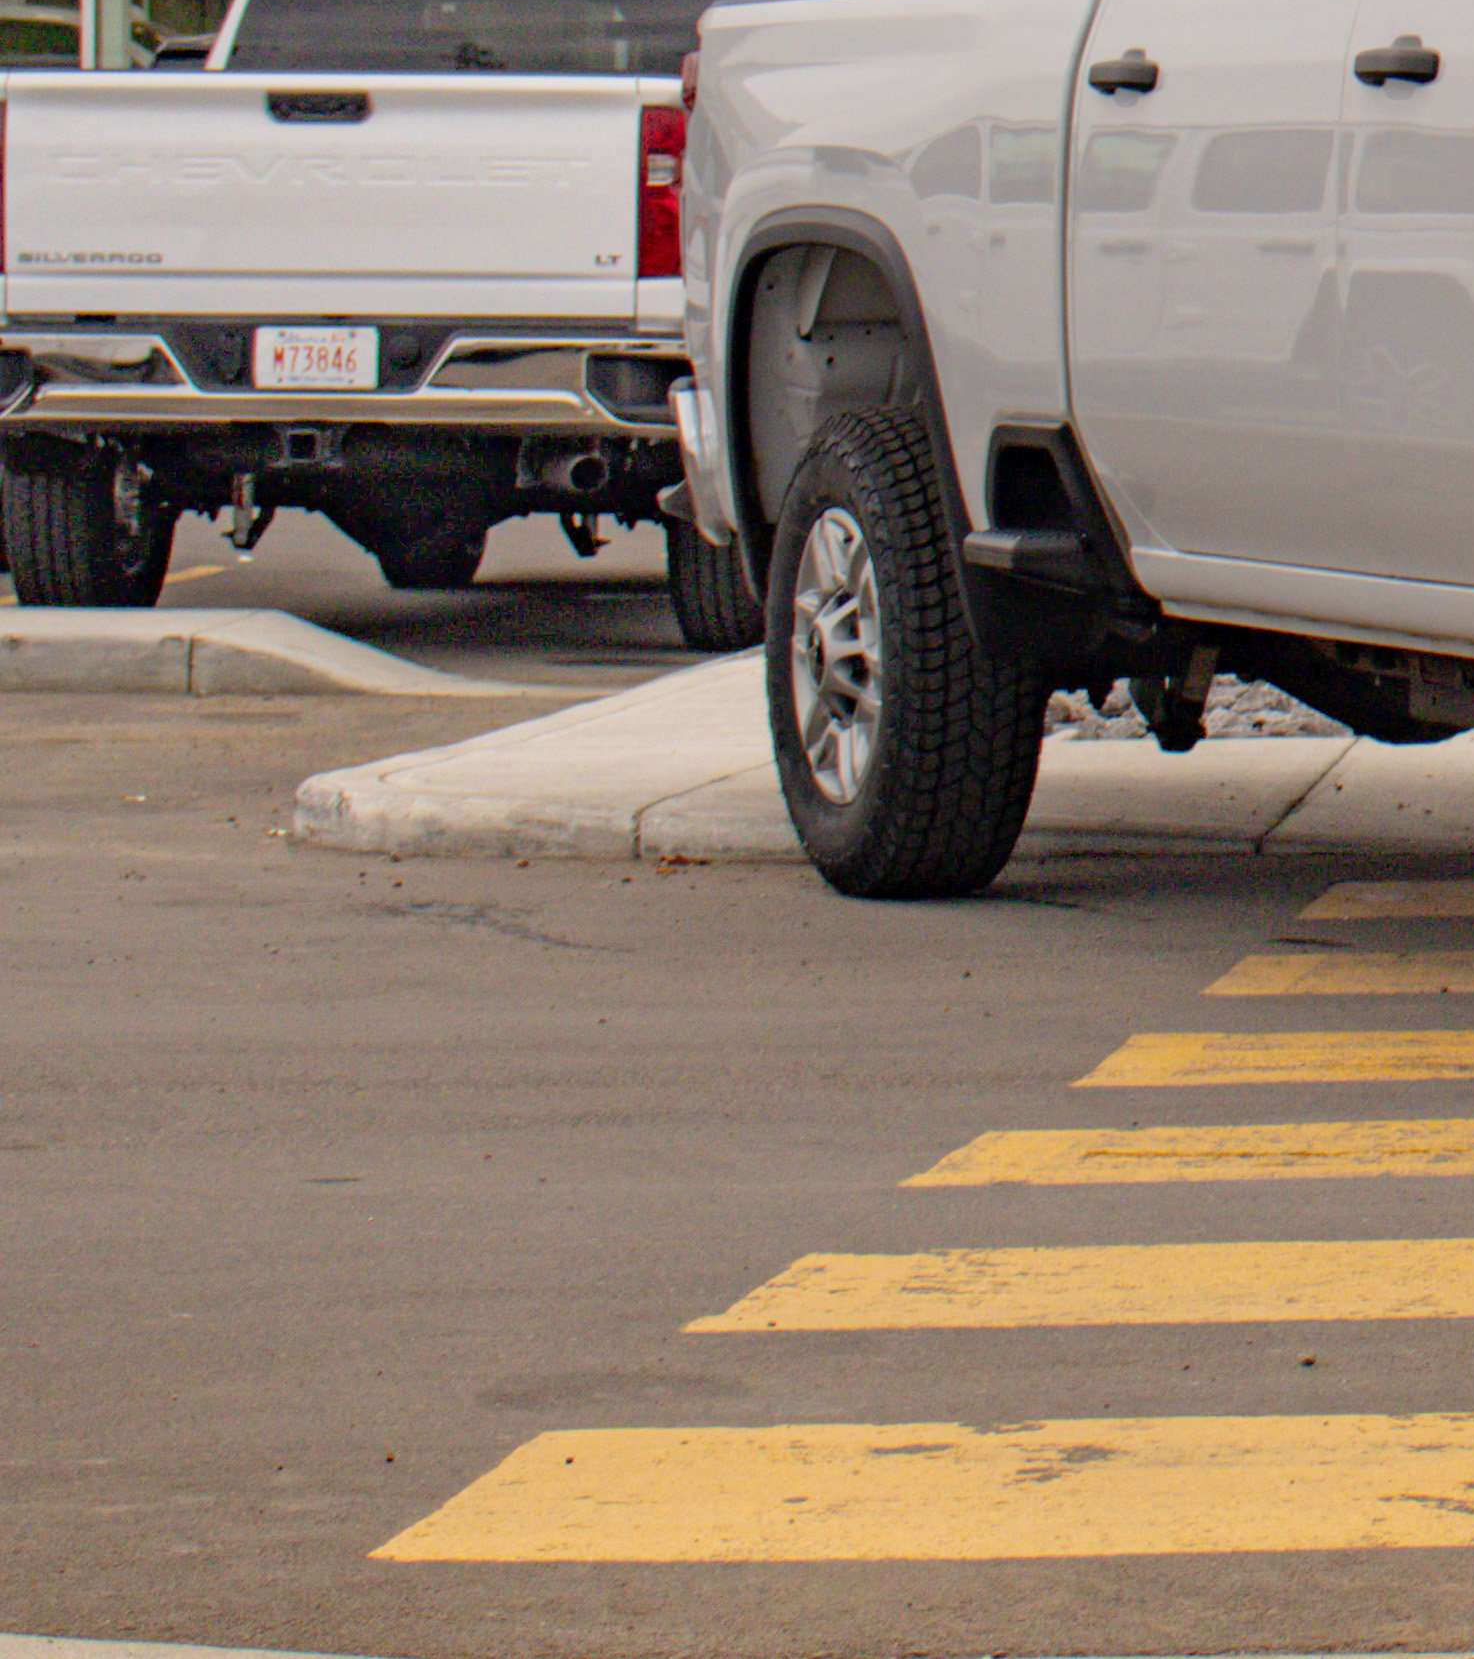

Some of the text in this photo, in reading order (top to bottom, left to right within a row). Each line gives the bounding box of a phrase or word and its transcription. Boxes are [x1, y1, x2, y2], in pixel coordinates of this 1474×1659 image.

[46, 151, 594, 187] CHEVROLET
[16, 250, 164, 264] SILVERADO
[594, 252, 624, 266] LT
